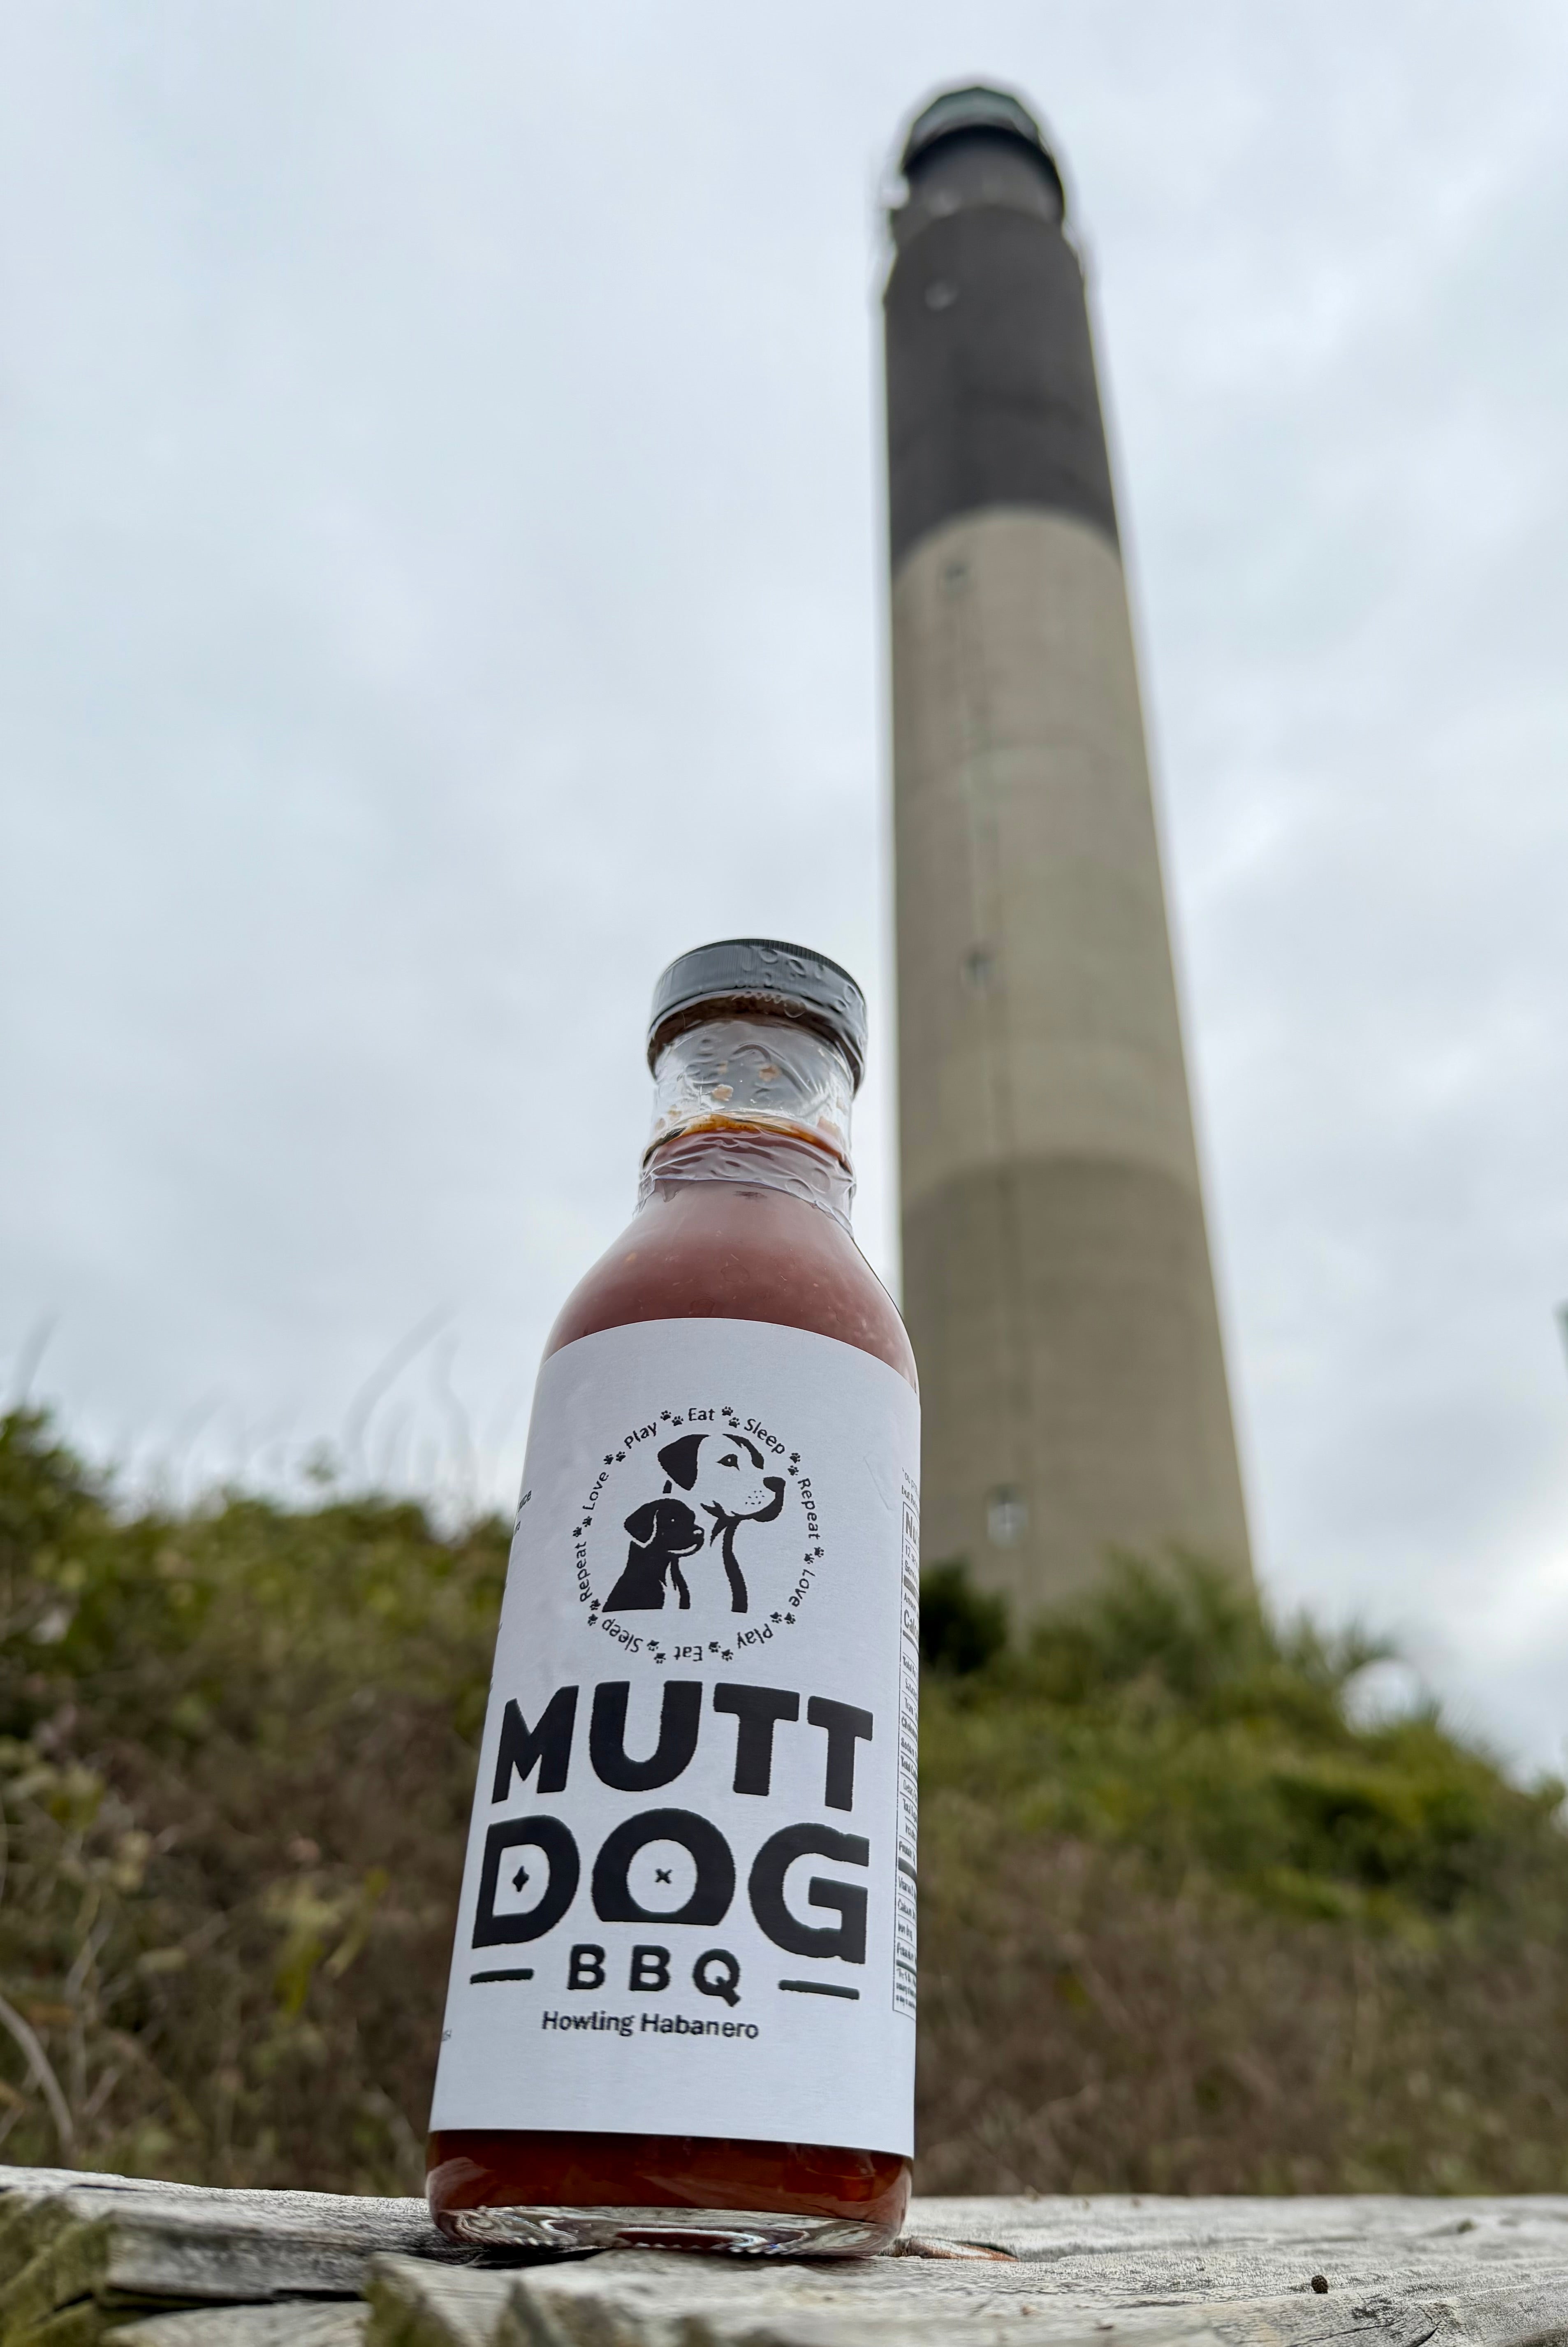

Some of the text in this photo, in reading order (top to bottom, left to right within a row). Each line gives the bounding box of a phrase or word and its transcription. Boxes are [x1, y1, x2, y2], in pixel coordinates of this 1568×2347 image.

[574, 1408, 820, 1662] Love Play Eat Sleep Repeat Love Play Eat Sleep Repeat
[491, 1680, 873, 1812] MUTT
[472, 1807, 870, 1964] DOG
[542, 2011, 759, 2039] Howling Habanero
[567, 1944, 741, 2007] BBQ
